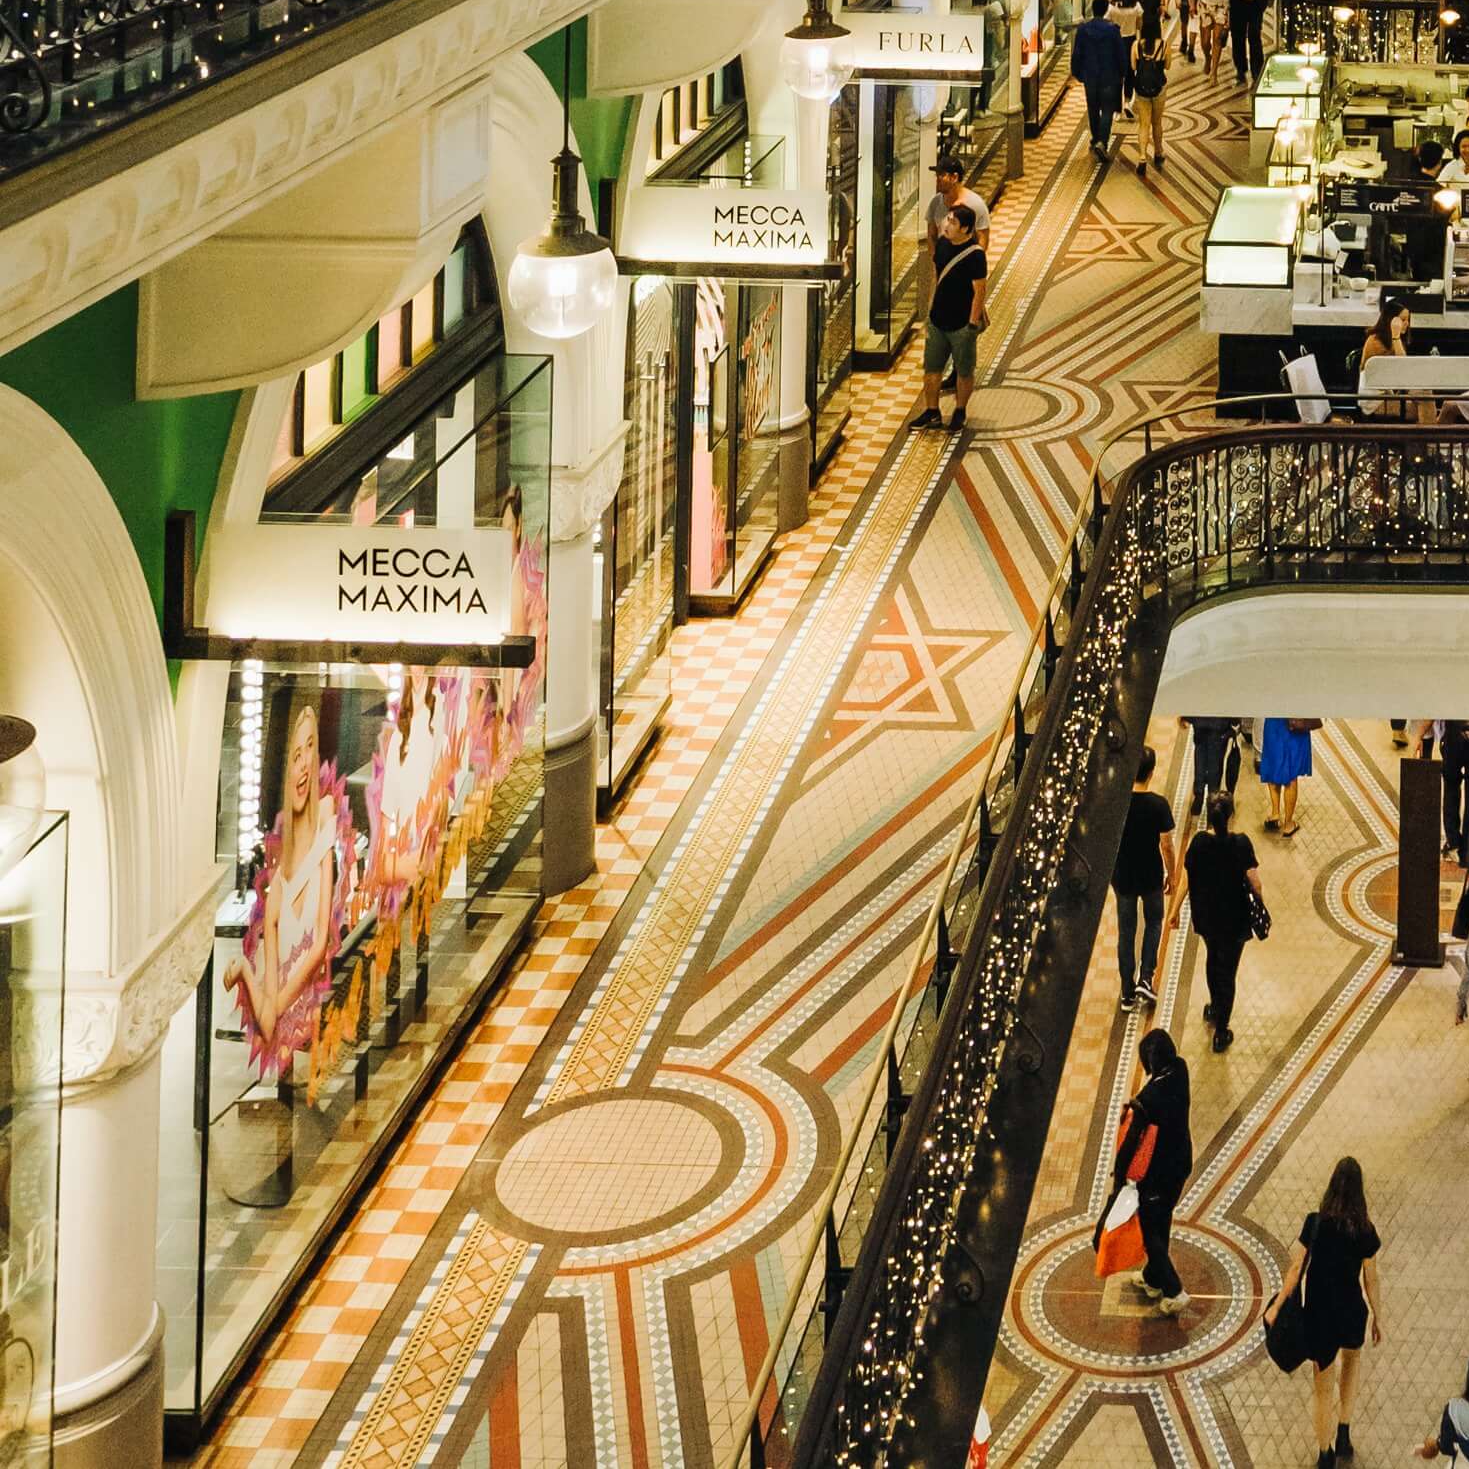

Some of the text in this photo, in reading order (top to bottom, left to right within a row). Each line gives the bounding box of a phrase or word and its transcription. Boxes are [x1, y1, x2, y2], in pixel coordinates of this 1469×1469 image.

[879, 31, 973, 53] FURLA
[714, 205, 805, 226] MECCA
[714, 229, 813, 249] MAXIMA
[338, 548, 474, 579] MECCA
[338, 584, 488, 614] MAXIMA
